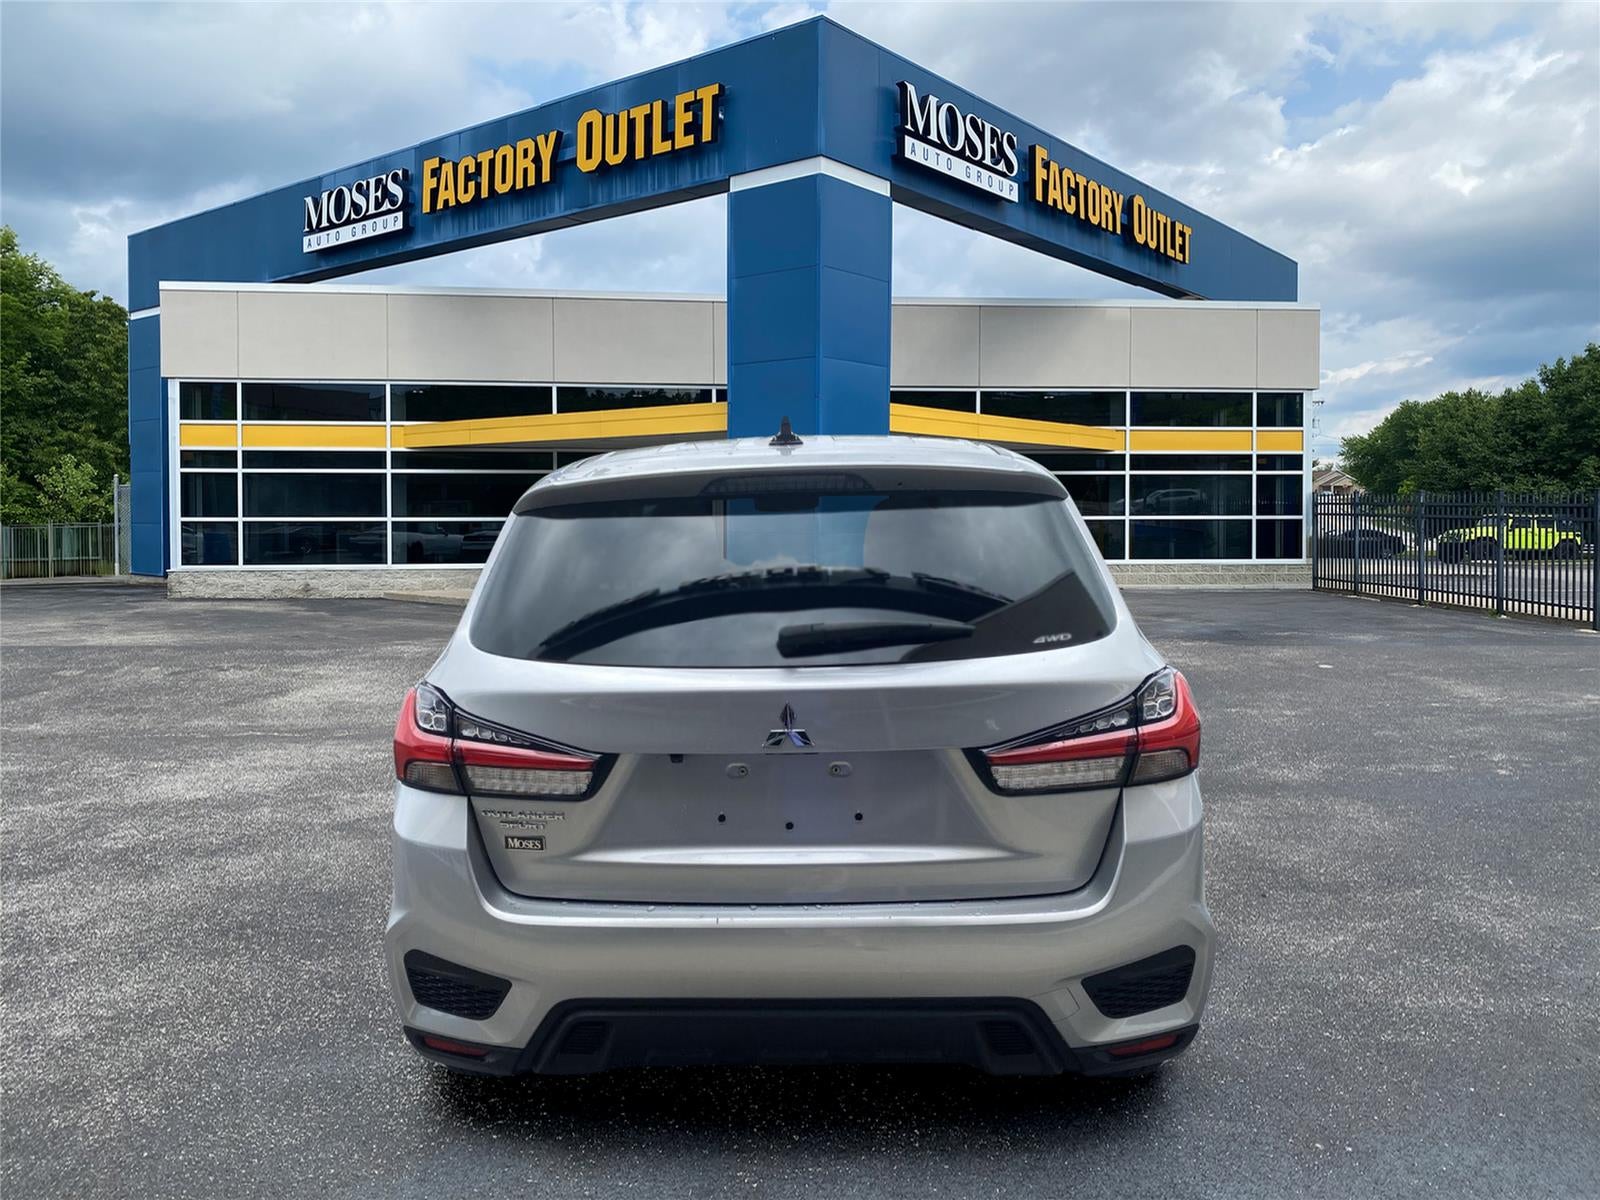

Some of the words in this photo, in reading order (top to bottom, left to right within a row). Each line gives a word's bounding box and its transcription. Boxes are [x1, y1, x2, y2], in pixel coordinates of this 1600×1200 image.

[421, 129, 560, 214] FACTORY
[576, 83, 720, 173] OUTLET
[904, 81, 1018, 177] MOSES
[910, 141, 953, 171] AUTO
[965, 165, 1015, 196] GROUP
[303, 169, 404, 232] MOSES
[1035, 144, 1124, 236] FACTORY
[1132, 194, 1192, 265] OUTLET
[306, 230, 341, 249] AUTO
[351, 216, 400, 239] GROUP
[1032, 632, 1072, 644] 4WD
[506, 837, 542, 850] MOSES
